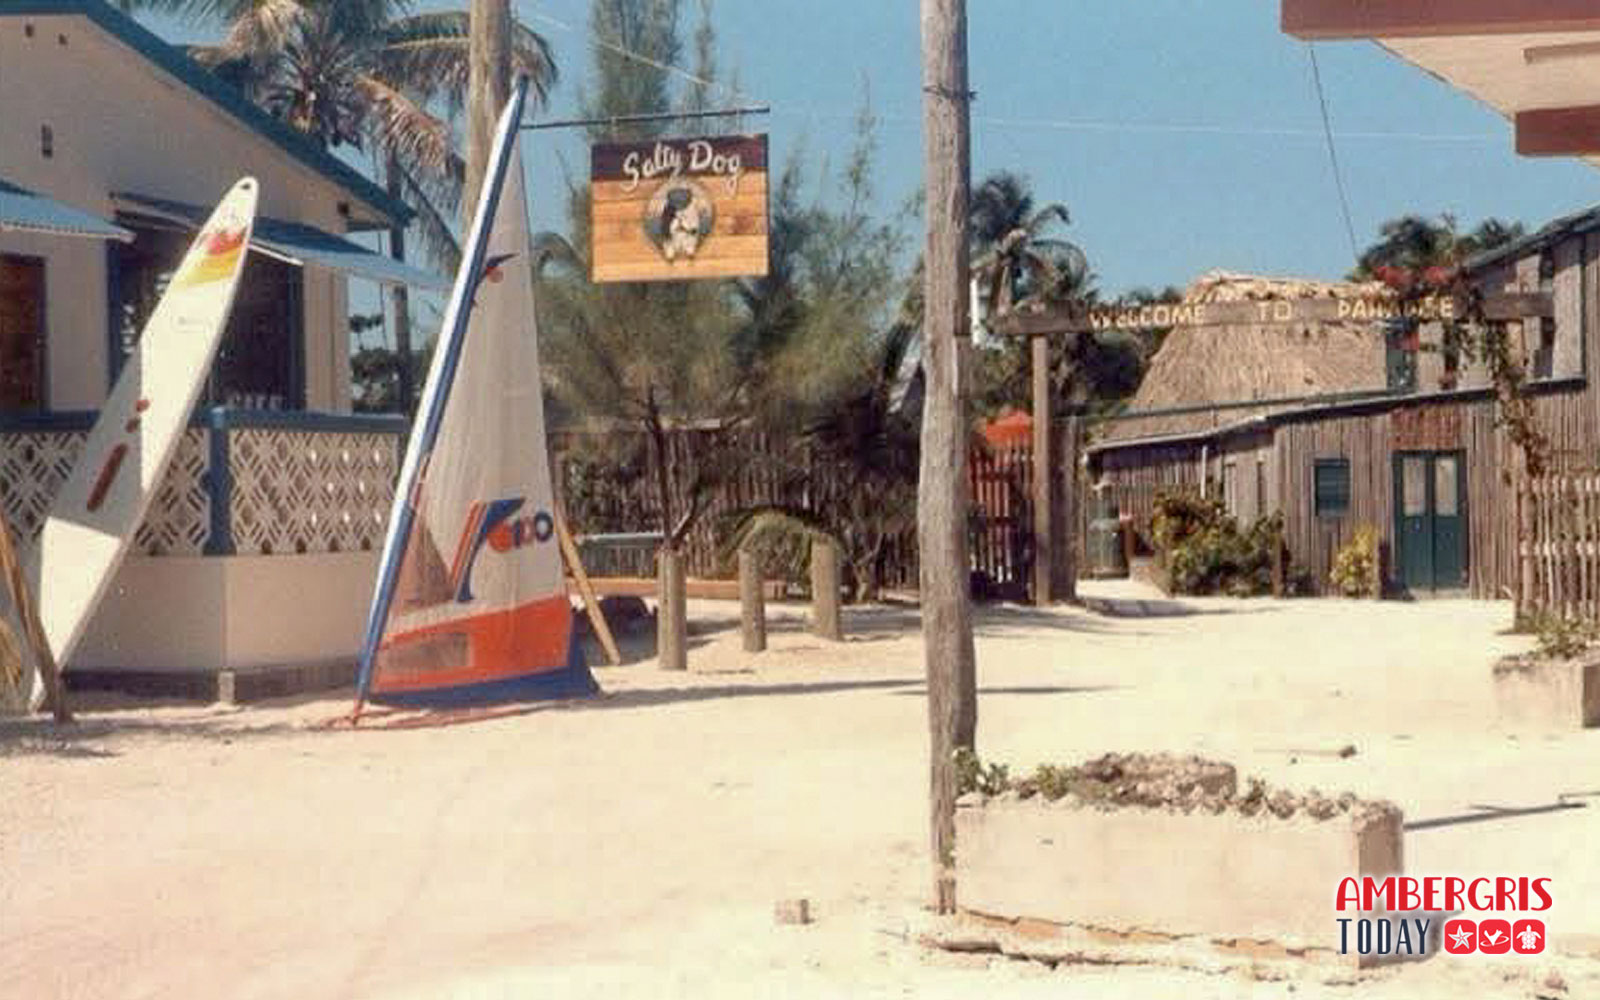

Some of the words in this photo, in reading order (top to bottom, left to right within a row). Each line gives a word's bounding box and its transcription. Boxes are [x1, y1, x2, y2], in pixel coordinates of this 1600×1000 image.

[620, 142, 682, 192] Salty
[688, 140, 741, 197] Dog
[1256, 300, 1293, 321] TO
